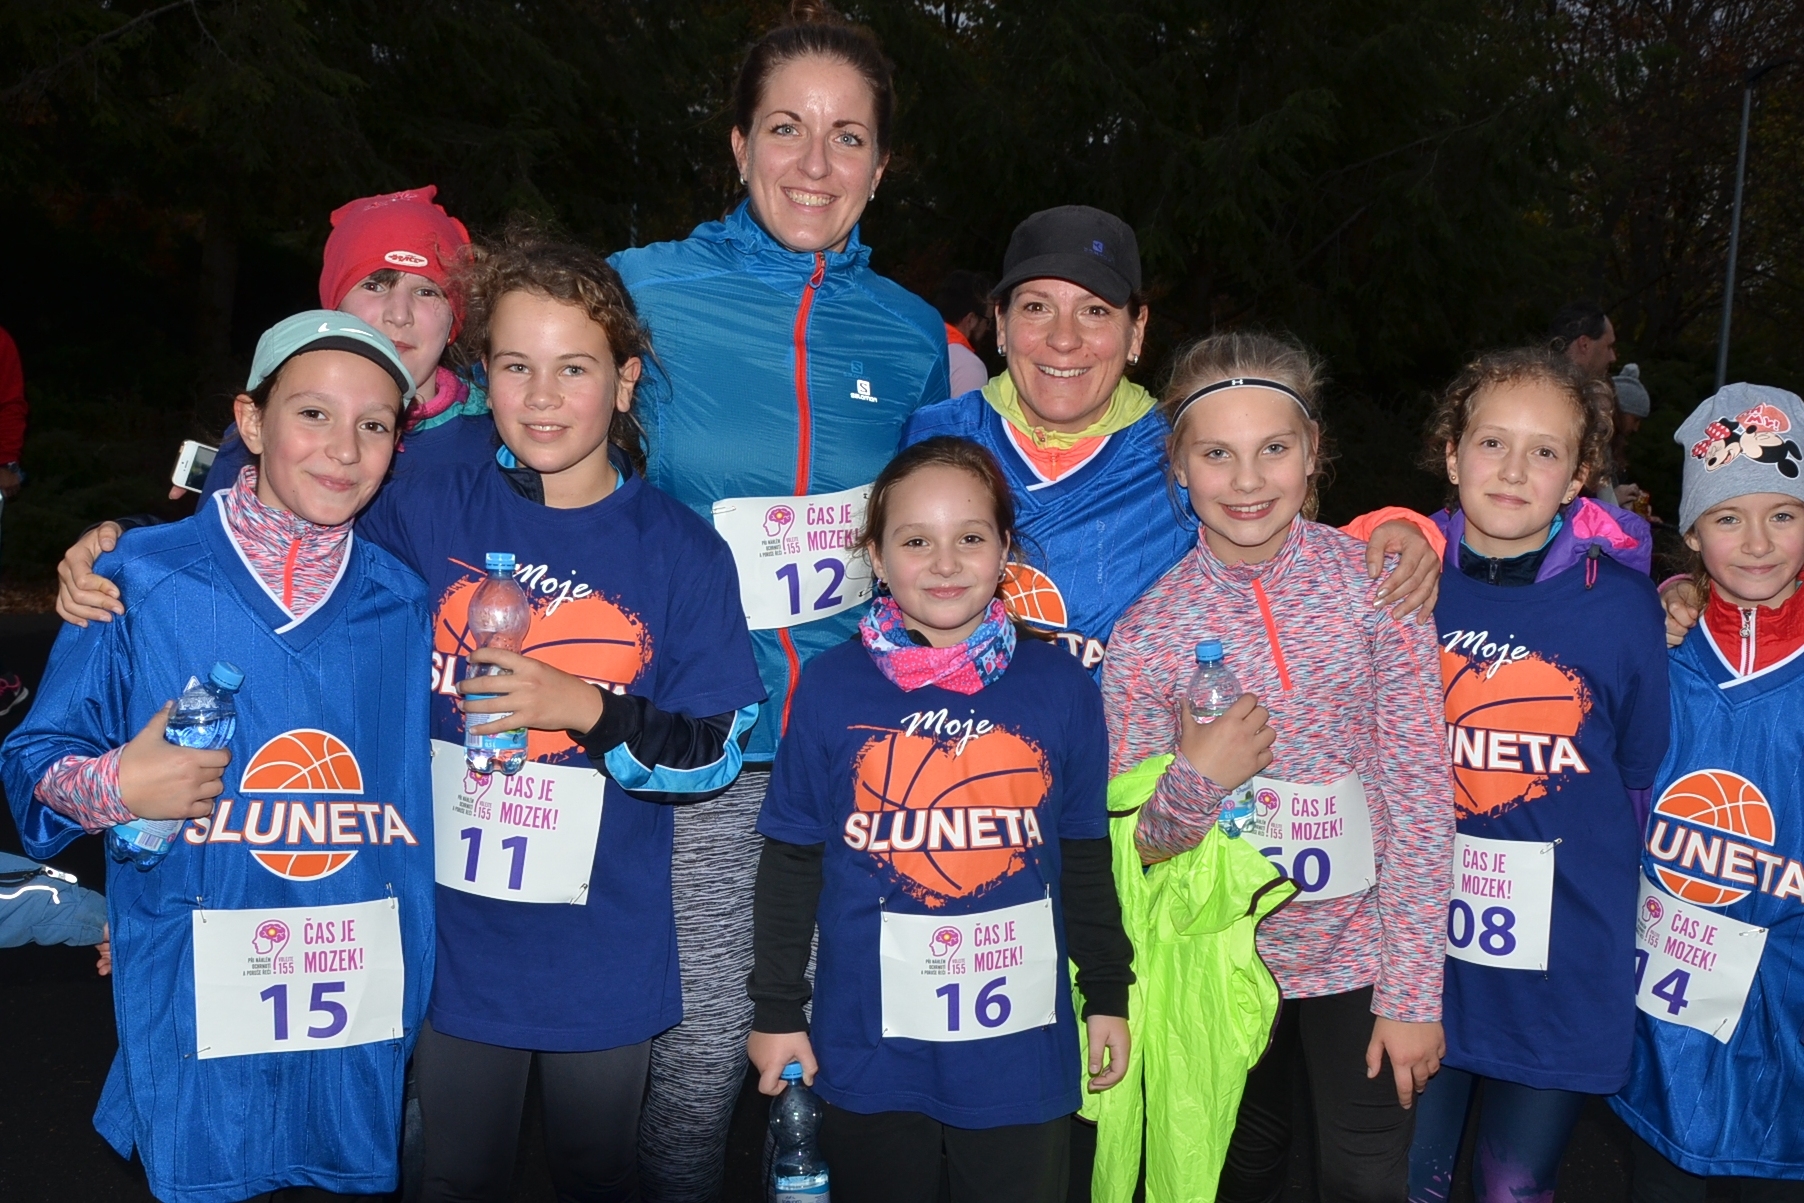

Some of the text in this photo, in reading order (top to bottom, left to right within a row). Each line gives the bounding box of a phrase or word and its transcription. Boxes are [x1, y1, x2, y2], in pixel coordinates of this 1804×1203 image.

[807, 503, 852, 526] ČAS JE
[786, 542, 800, 554] 155
[807, 528, 860, 552] MOZEK!
[512, 563, 592, 616] Moje
[775, 558, 845, 616] 12
[1442, 630, 1530, 680] Moje
[900, 708, 994, 756] Moje
[1448, 724, 1590, 774] NETA
[538, 779, 555, 801] JE
[478, 806, 491, 820] 155
[500, 802, 558, 830] MOZEK!
[1292, 793, 1337, 817] ČAS JE
[184, 800, 418, 845] SLUNETA
[844, 807, 1044, 852] SLUNETA
[1270, 827, 1283, 840] 155
[1292, 818, 1343, 841] MOZEK!
[460, 826, 528, 890] 11
[1463, 844, 1506, 873] ČAS JE
[1648, 820, 1804, 904] UNETA
[1462, 873, 1512, 900] MOZEK!
[304, 918, 355, 945] ČAS JE
[974, 921, 1016, 947] ČAS JE
[1447, 898, 1516, 956] 08
[1671, 910, 1700, 939] ČAS
[1700, 925, 1718, 946] JE
[1648, 935, 1660, 948] 155
[1664, 936, 1717, 972] MOZEK!
[279, 963, 294, 974] 155
[304, 948, 364, 973] MOZEK!
[952, 964, 966, 974] 155
[974, 945, 1023, 972] MOZEK!
[1635, 948, 1691, 1016] 14
[260, 981, 348, 1040] 15
[935, 976, 1011, 1031] 16
